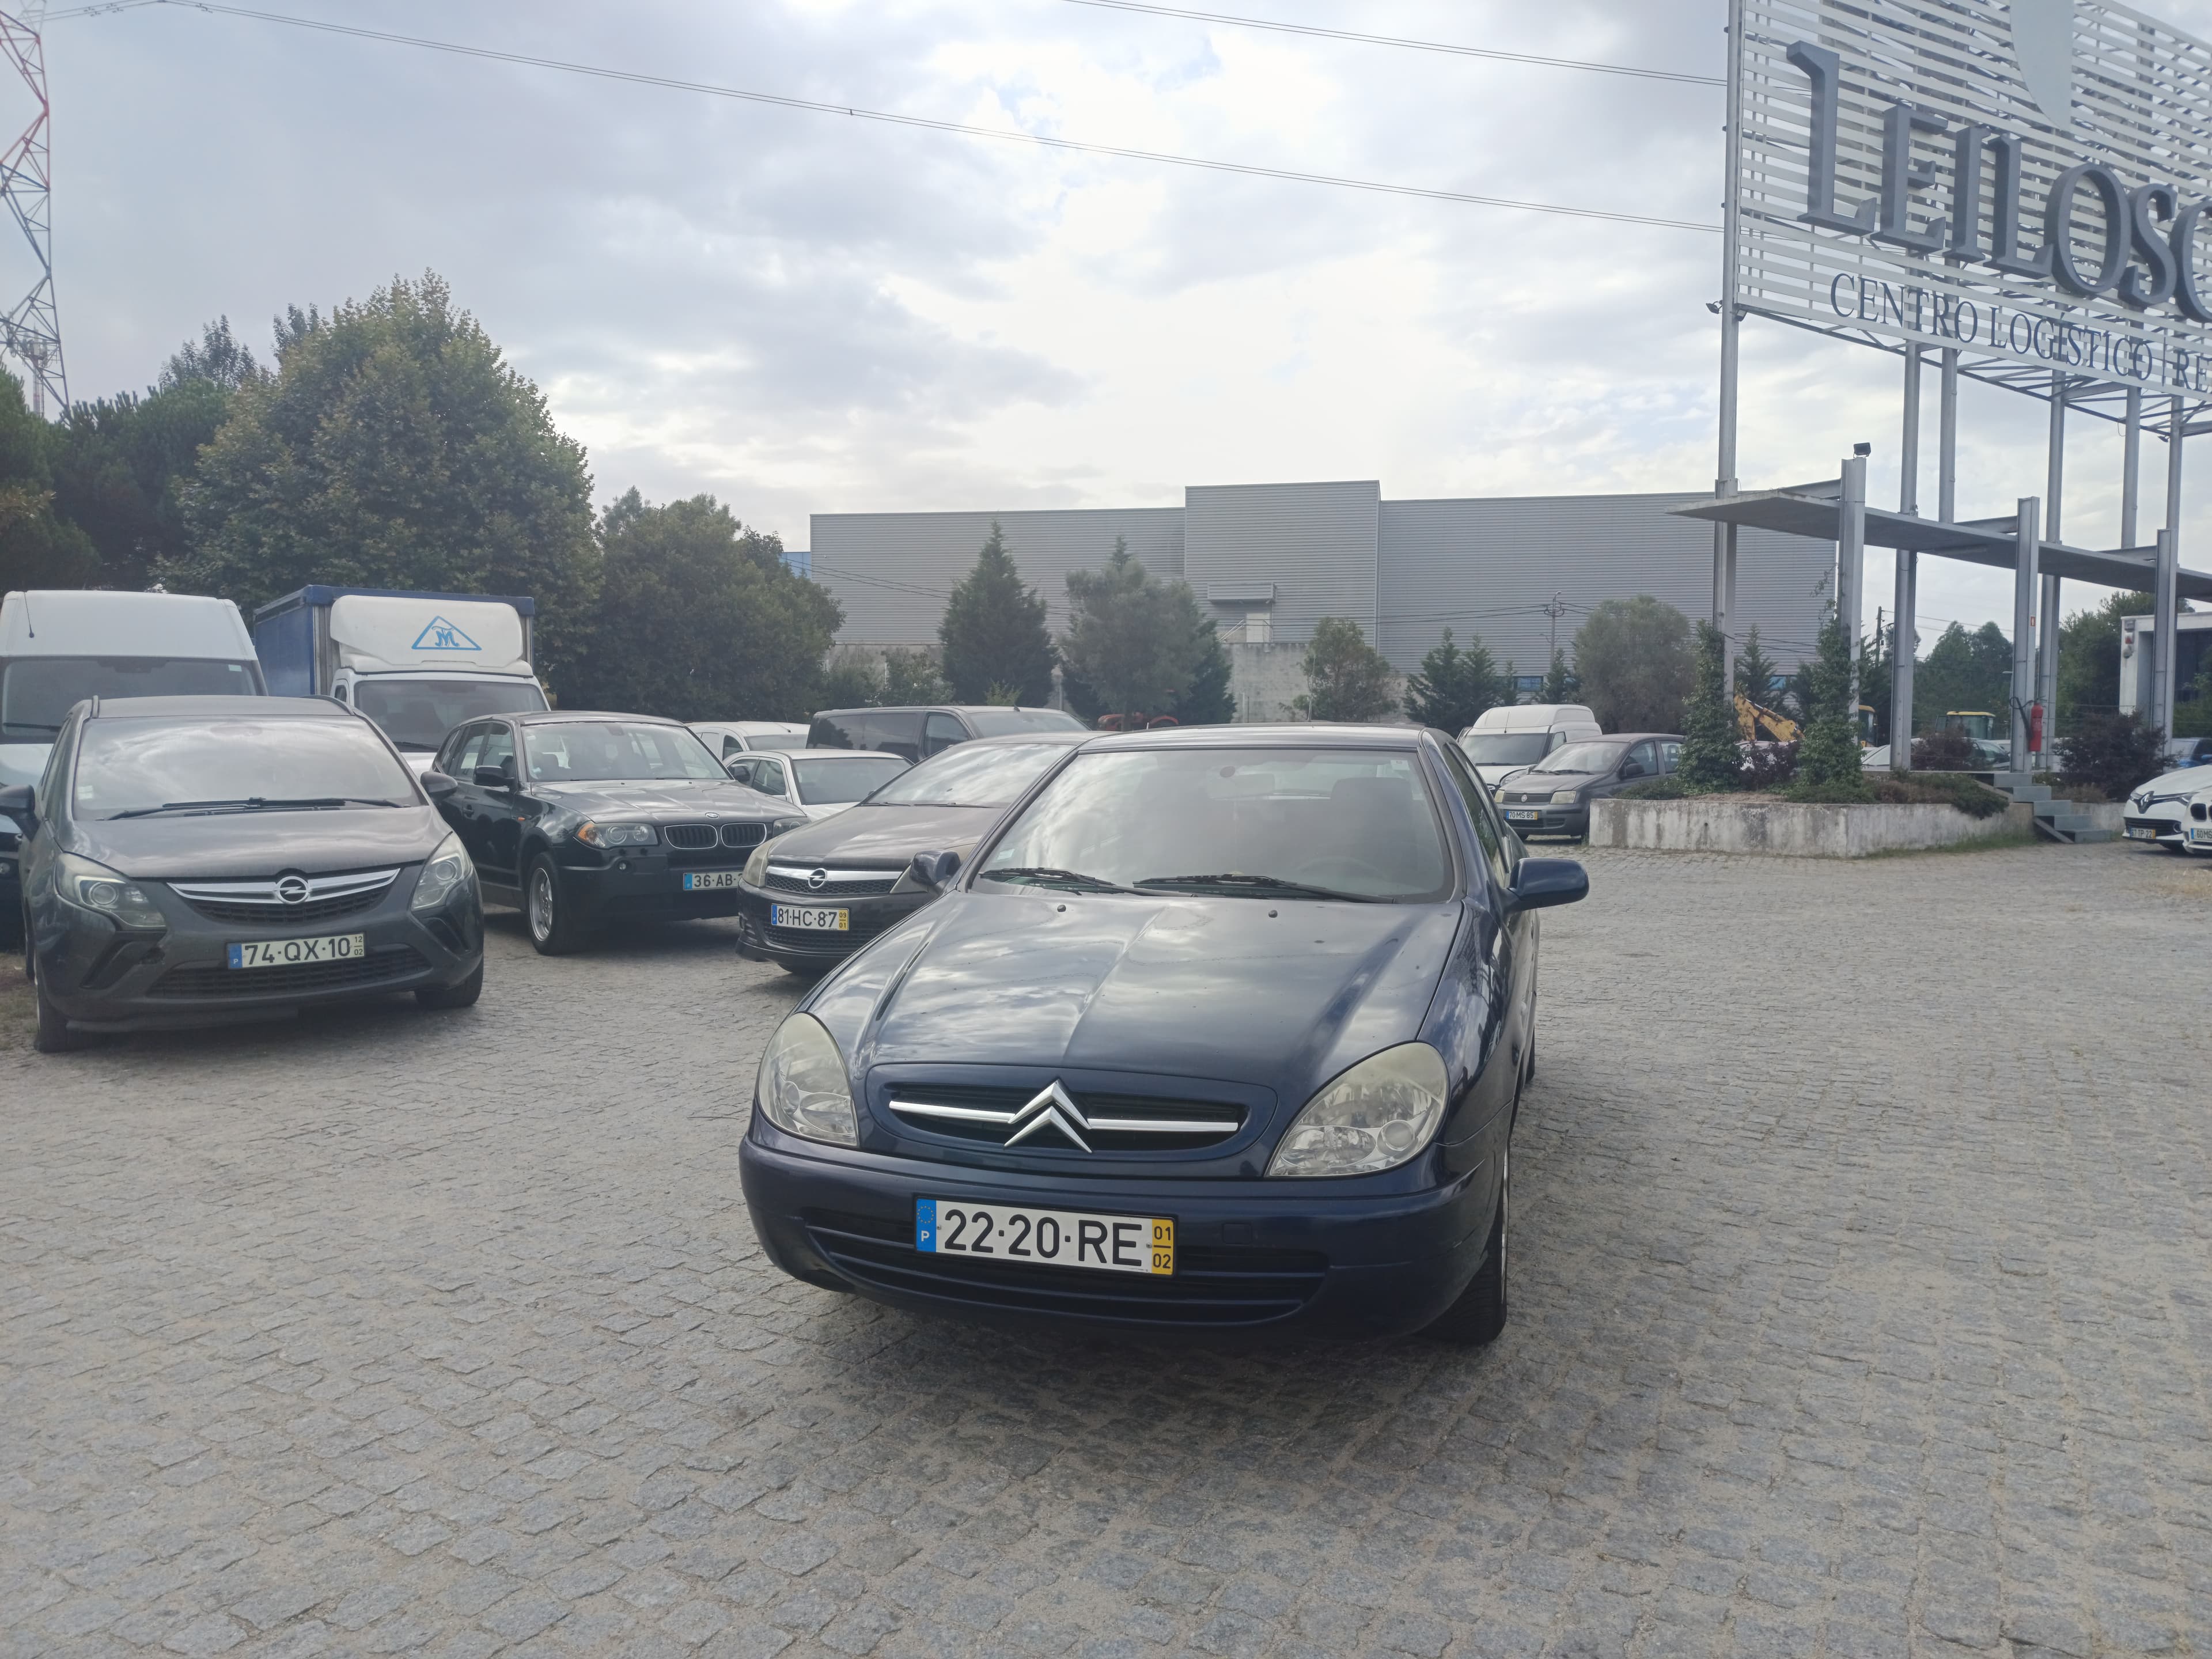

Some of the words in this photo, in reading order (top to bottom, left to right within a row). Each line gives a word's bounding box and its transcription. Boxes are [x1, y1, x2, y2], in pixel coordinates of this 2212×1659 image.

[1831, 273, 1978, 343] CENTRO
[1988, 306, 2153, 381] LOGÍSTICO
[921, 1230, 930, 1242] P
[1154, 1225, 1172, 1241] 01
[1153, 1253, 1172, 1270] 02
